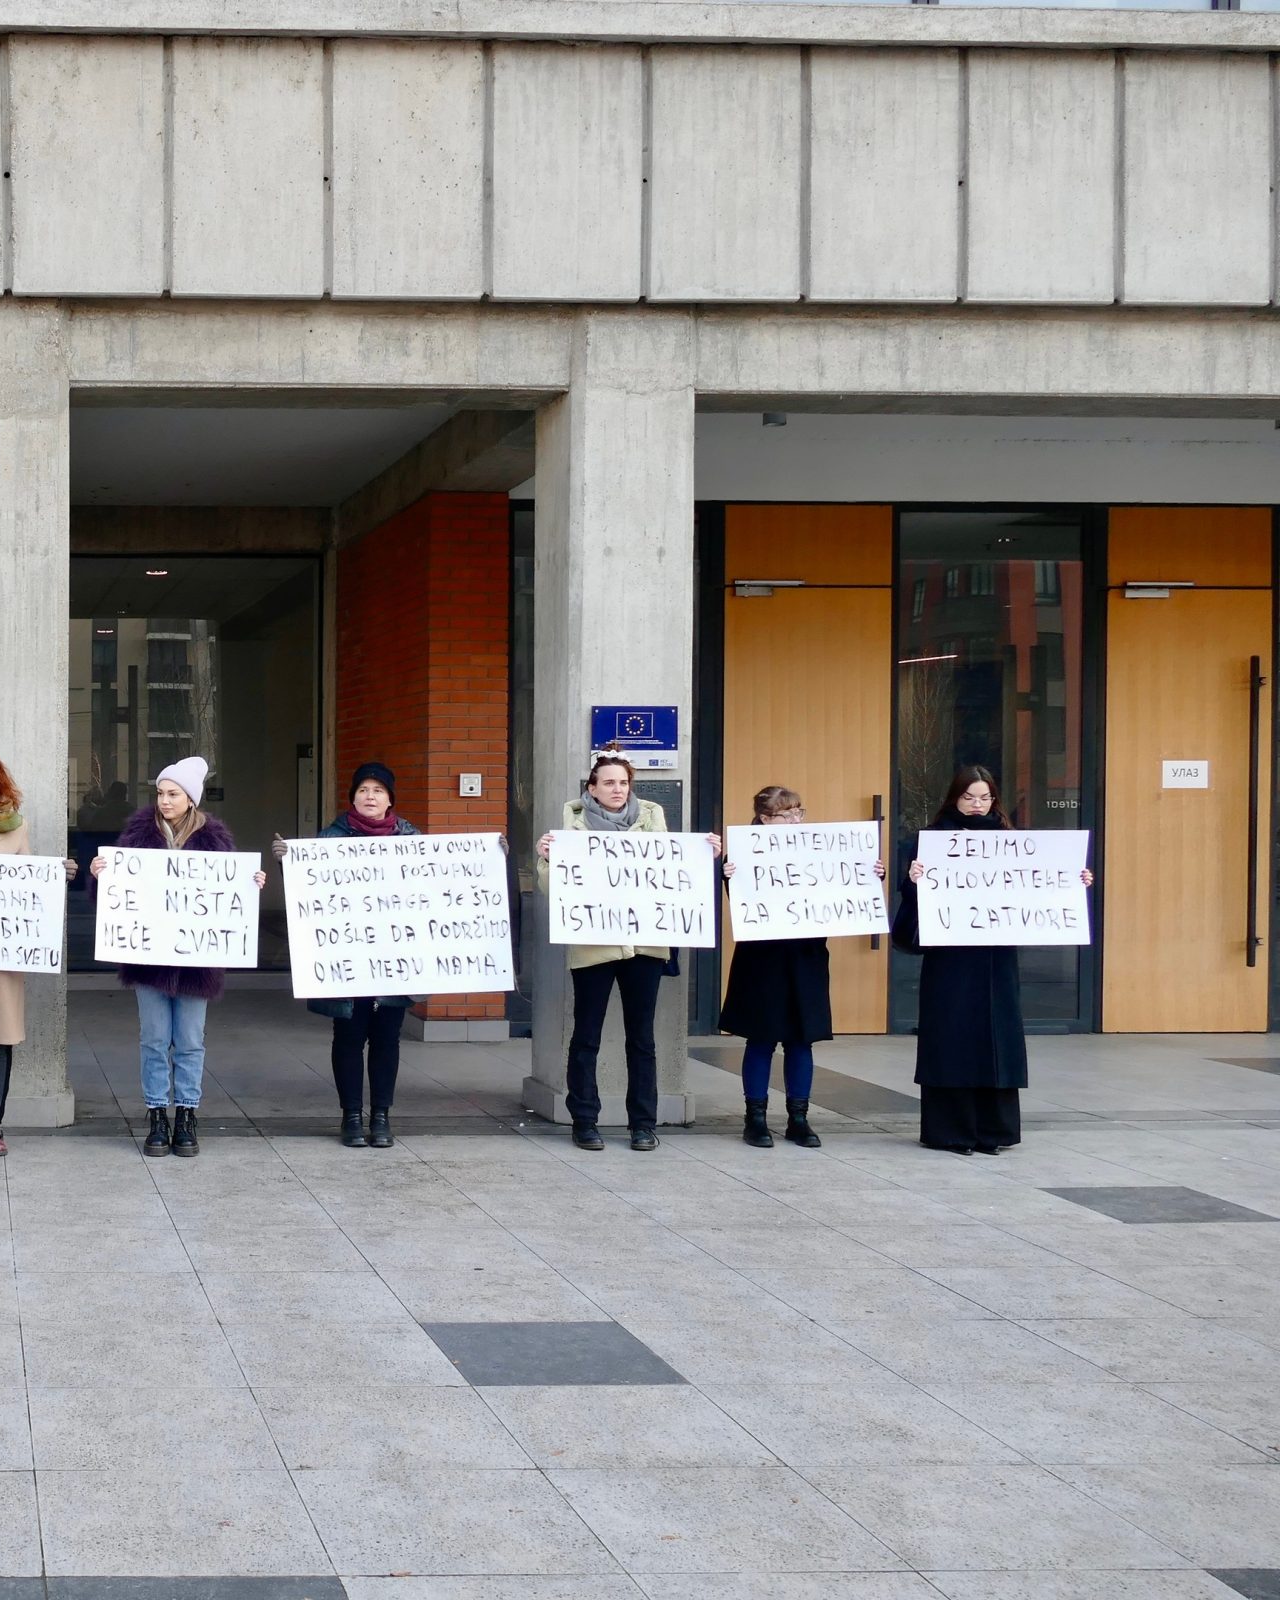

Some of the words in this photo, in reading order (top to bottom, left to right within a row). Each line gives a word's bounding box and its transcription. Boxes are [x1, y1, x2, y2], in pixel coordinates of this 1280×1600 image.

[1171, 768, 1199, 777] УЛАЗ
[290, 843, 329, 864] NAŠA
[395, 840, 425, 856] NIJE
[447, 839, 486, 854] OVOM
[589, 836, 683, 861] PRAVDA
[751, 830, 874, 854] ZAHTEVAMO
[947, 833, 1037, 859] ŽELIMO
[114, 851, 141, 875] PO
[307, 866, 385, 885] SUDSKOM
[557, 860, 583, 885] JE
[607, 866, 691, 892] UMRLA
[754, 862, 871, 891] PRESUDE
[108, 885, 139, 911] SE
[166, 887, 243, 916] NIŠTA
[298, 894, 351, 919] NAŠA
[363, 894, 429, 912] SNAGA
[471, 885, 502, 906] ŠTO
[741, 902, 770, 924] ZA
[1, 917, 40, 938] BITI
[560, 898, 639, 935] ISTINA
[655, 901, 704, 934] ŽIVI
[938, 907, 950, 930] U
[970, 906, 1078, 930] ZATVORE
[105, 921, 151, 951] NEĆE
[175, 926, 248, 956] ZVATI
[315, 923, 375, 947] DOŠLE
[391, 925, 415, 942] DA
[17, 946, 59, 967] SVETU
[314, 960, 355, 984] ONE
[437, 953, 507, 976] NAMA.
